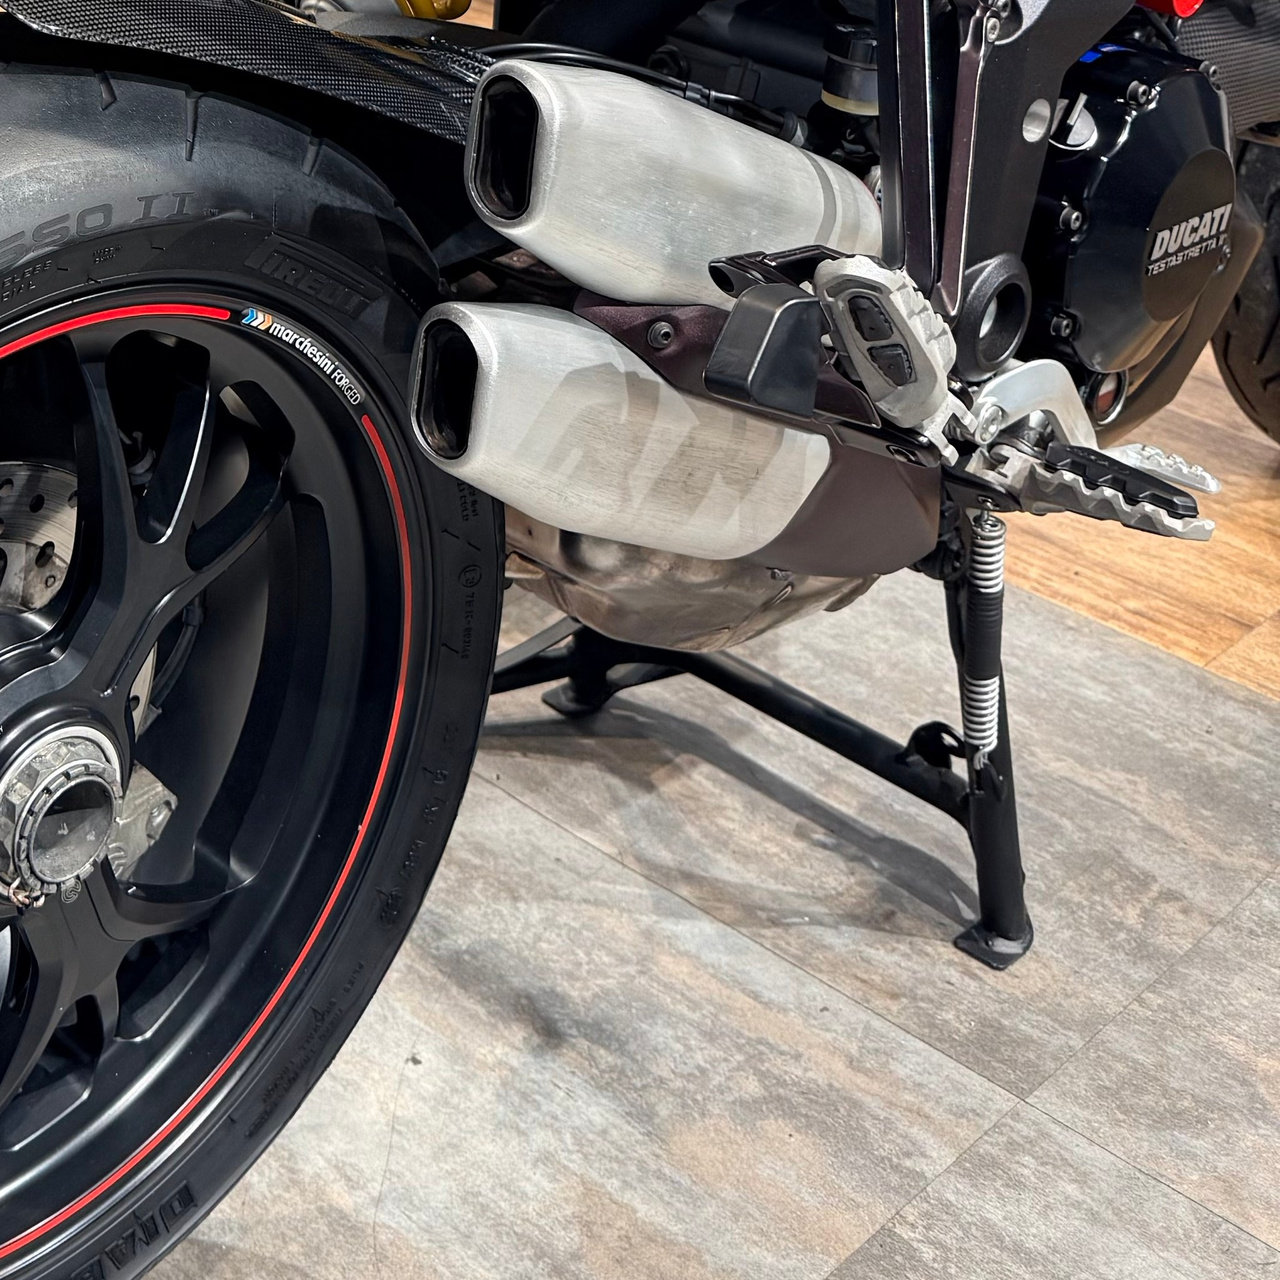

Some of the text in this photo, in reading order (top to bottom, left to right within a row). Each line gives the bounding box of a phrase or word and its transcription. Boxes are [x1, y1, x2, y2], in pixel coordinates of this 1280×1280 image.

[1145, 238, 1217, 278] TESTASTRETTA
[1149, 201, 1234, 262] DUCATI
[268, 322, 362, 406] marchesini FORGED
